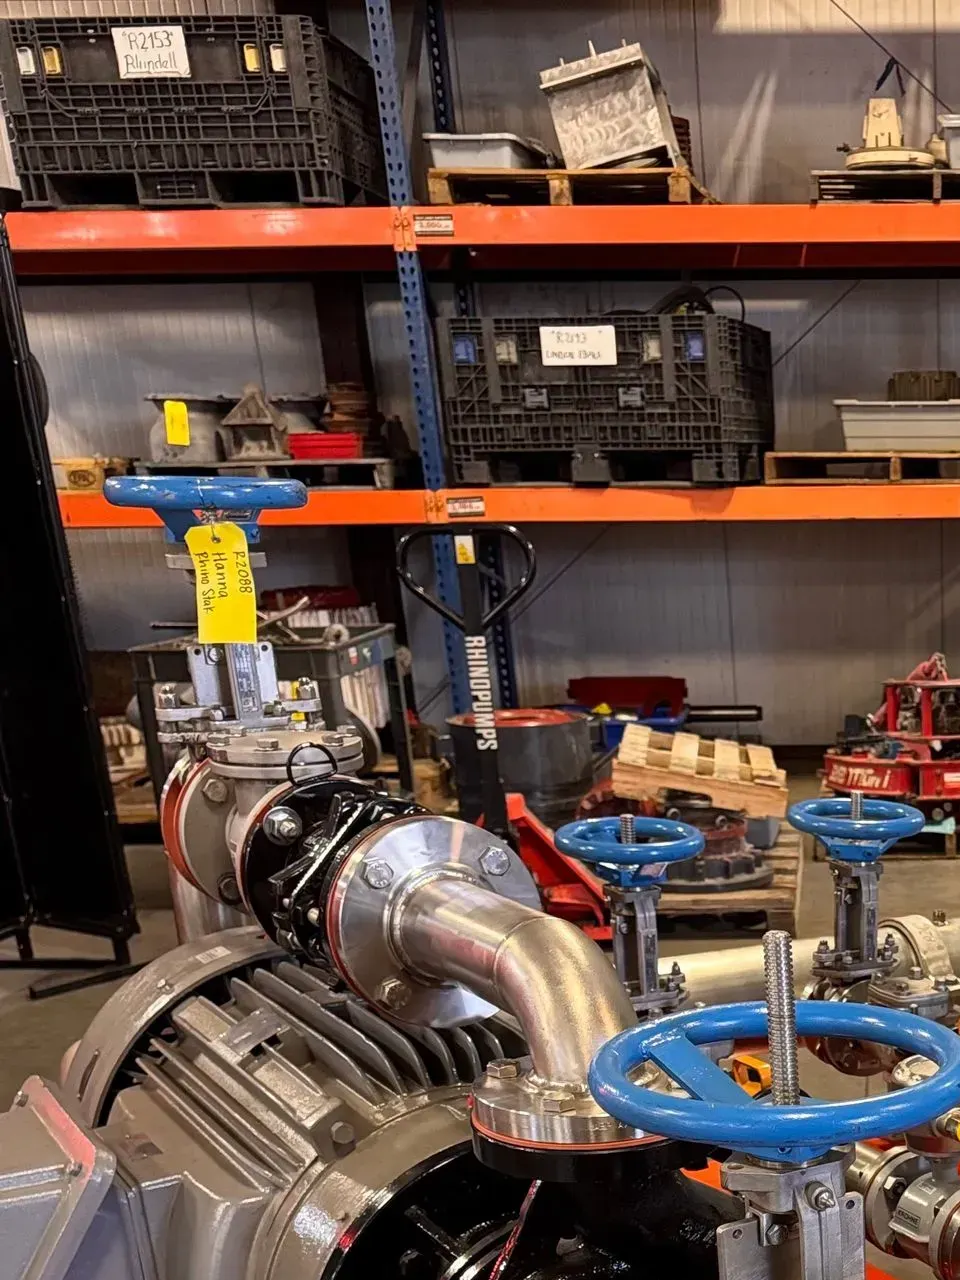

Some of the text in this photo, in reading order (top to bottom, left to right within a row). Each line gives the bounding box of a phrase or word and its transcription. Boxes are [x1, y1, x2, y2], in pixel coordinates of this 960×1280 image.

[211, 552, 229, 598] Hanna
[233, 551, 253, 594] R2088
[464, 635, 498, 751] RHINOPUMPS
